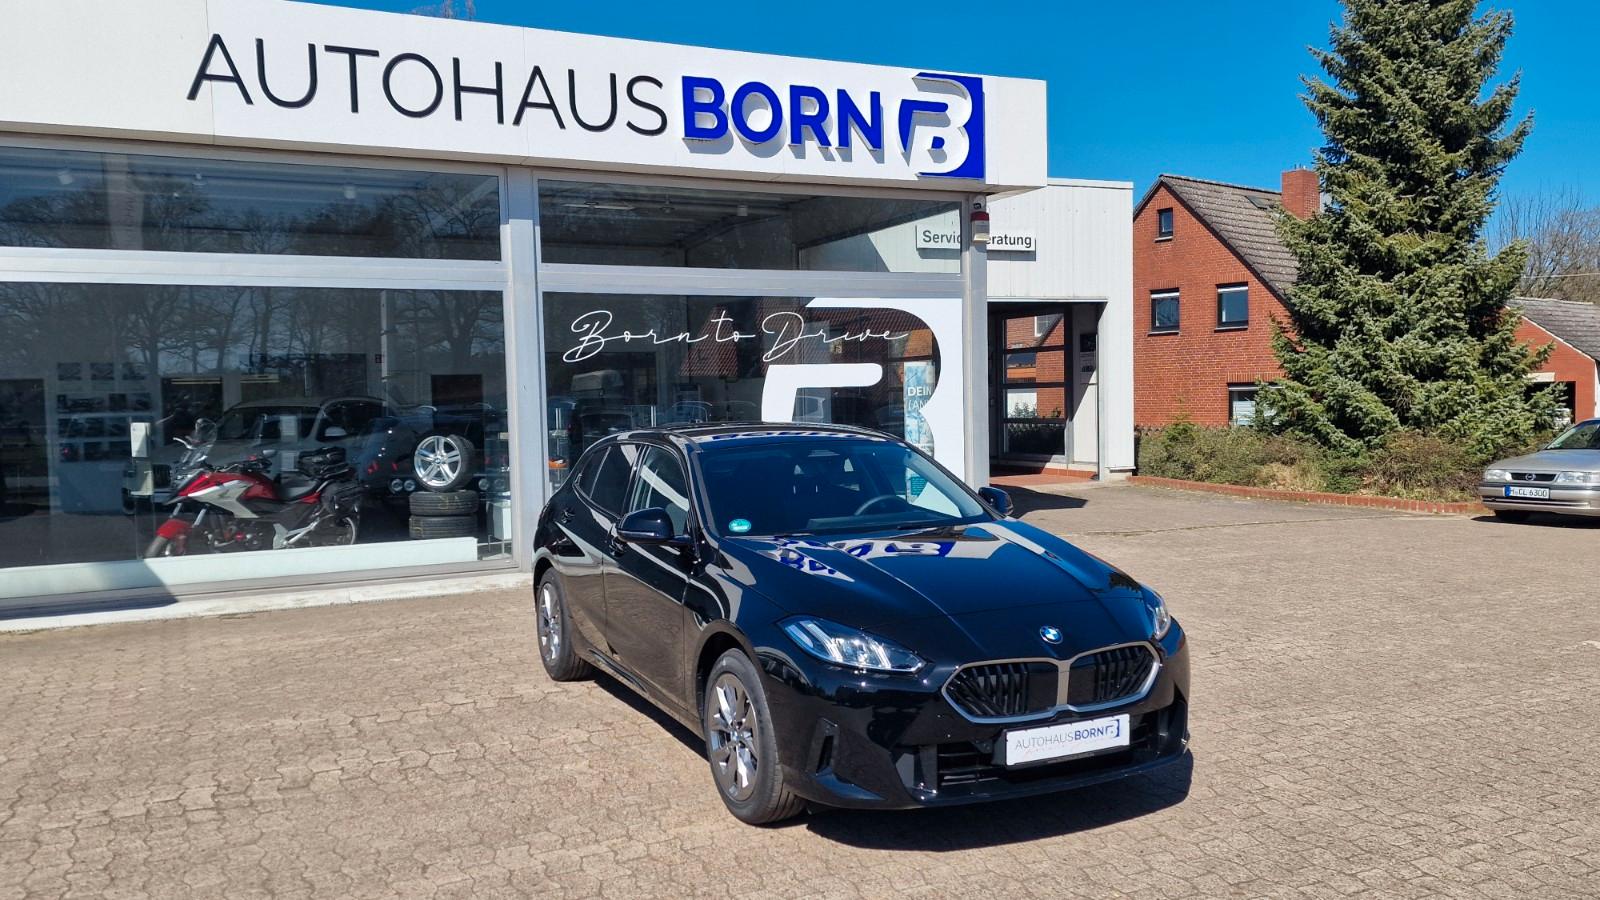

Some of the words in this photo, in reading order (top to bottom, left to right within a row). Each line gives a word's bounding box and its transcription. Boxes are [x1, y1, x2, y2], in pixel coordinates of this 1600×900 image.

[562, 310, 709, 363] Born
[710, 310, 756, 343] to
[761, 310, 909, 362] Drive
